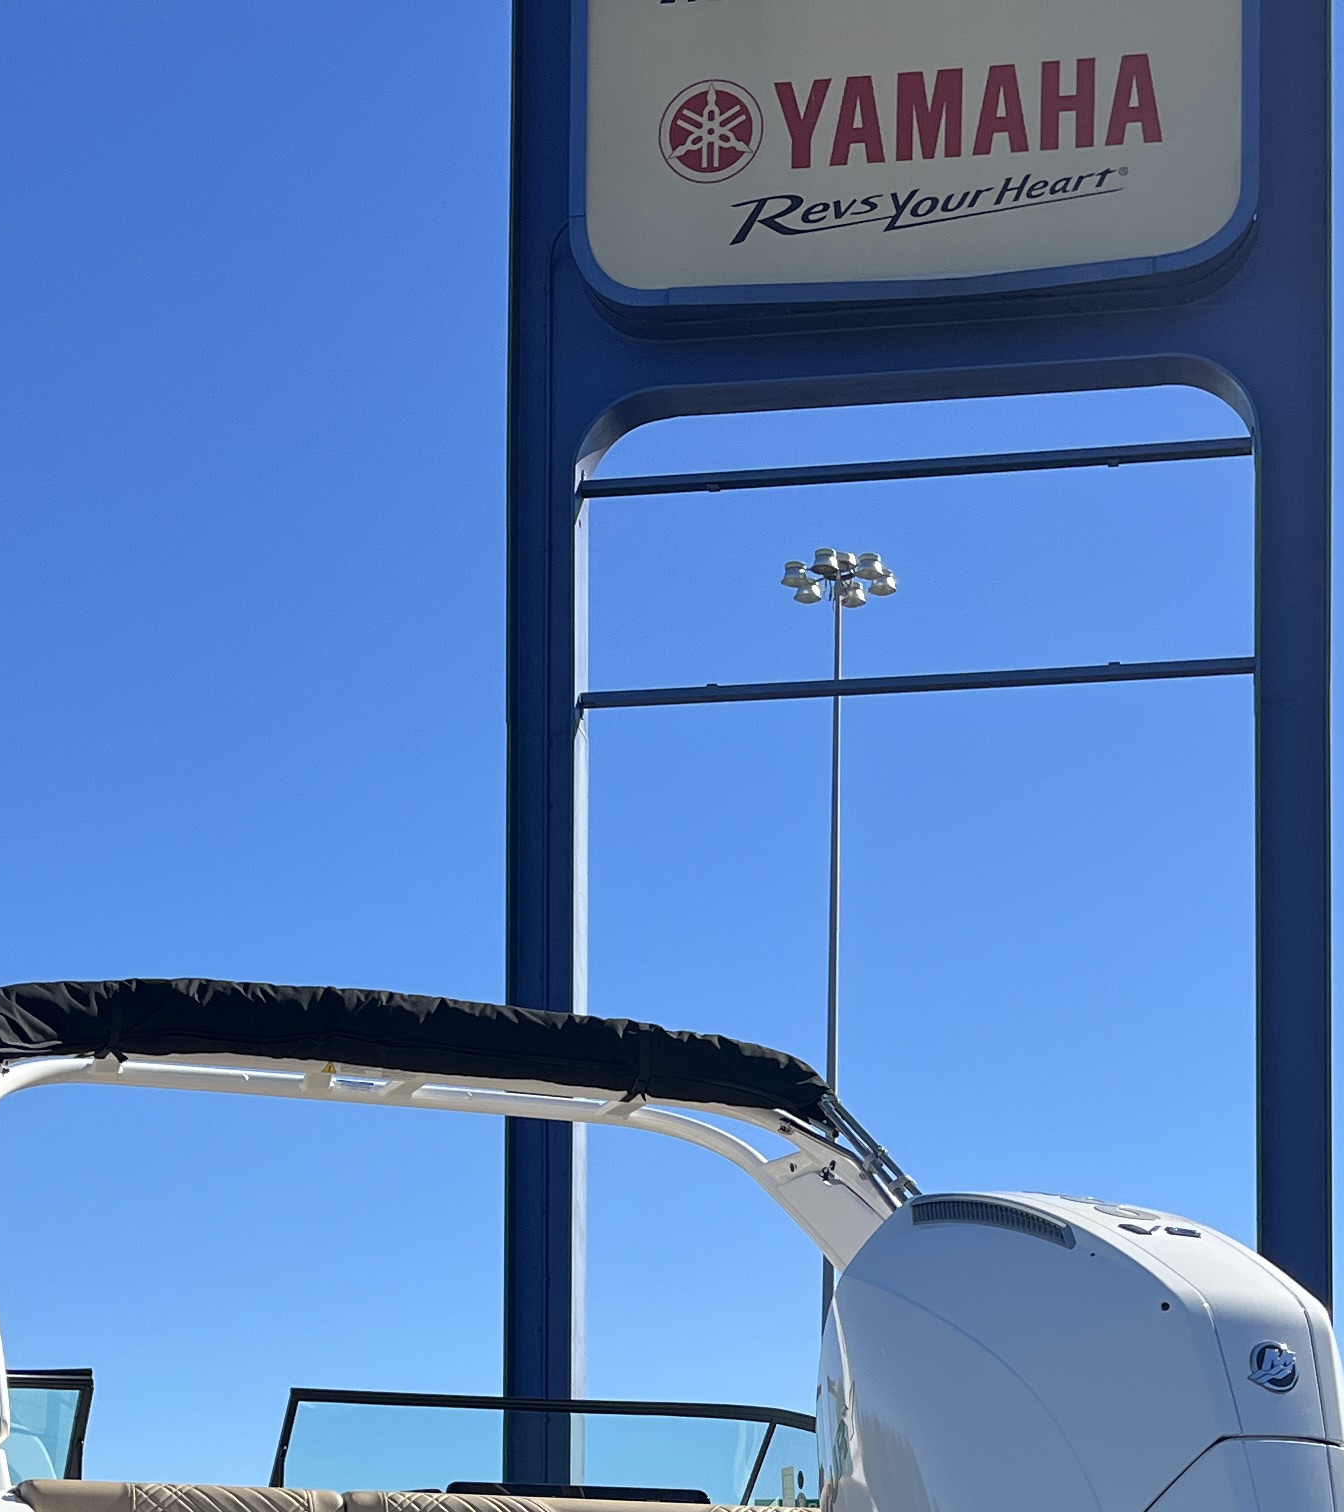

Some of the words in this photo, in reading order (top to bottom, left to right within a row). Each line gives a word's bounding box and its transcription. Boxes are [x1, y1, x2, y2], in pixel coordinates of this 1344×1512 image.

[773, 53, 1163, 169] YAMAHA
[729, 193, 884, 246] Revs
[884, 188, 994, 232] Your
[994, 167, 1118, 206] Heart
